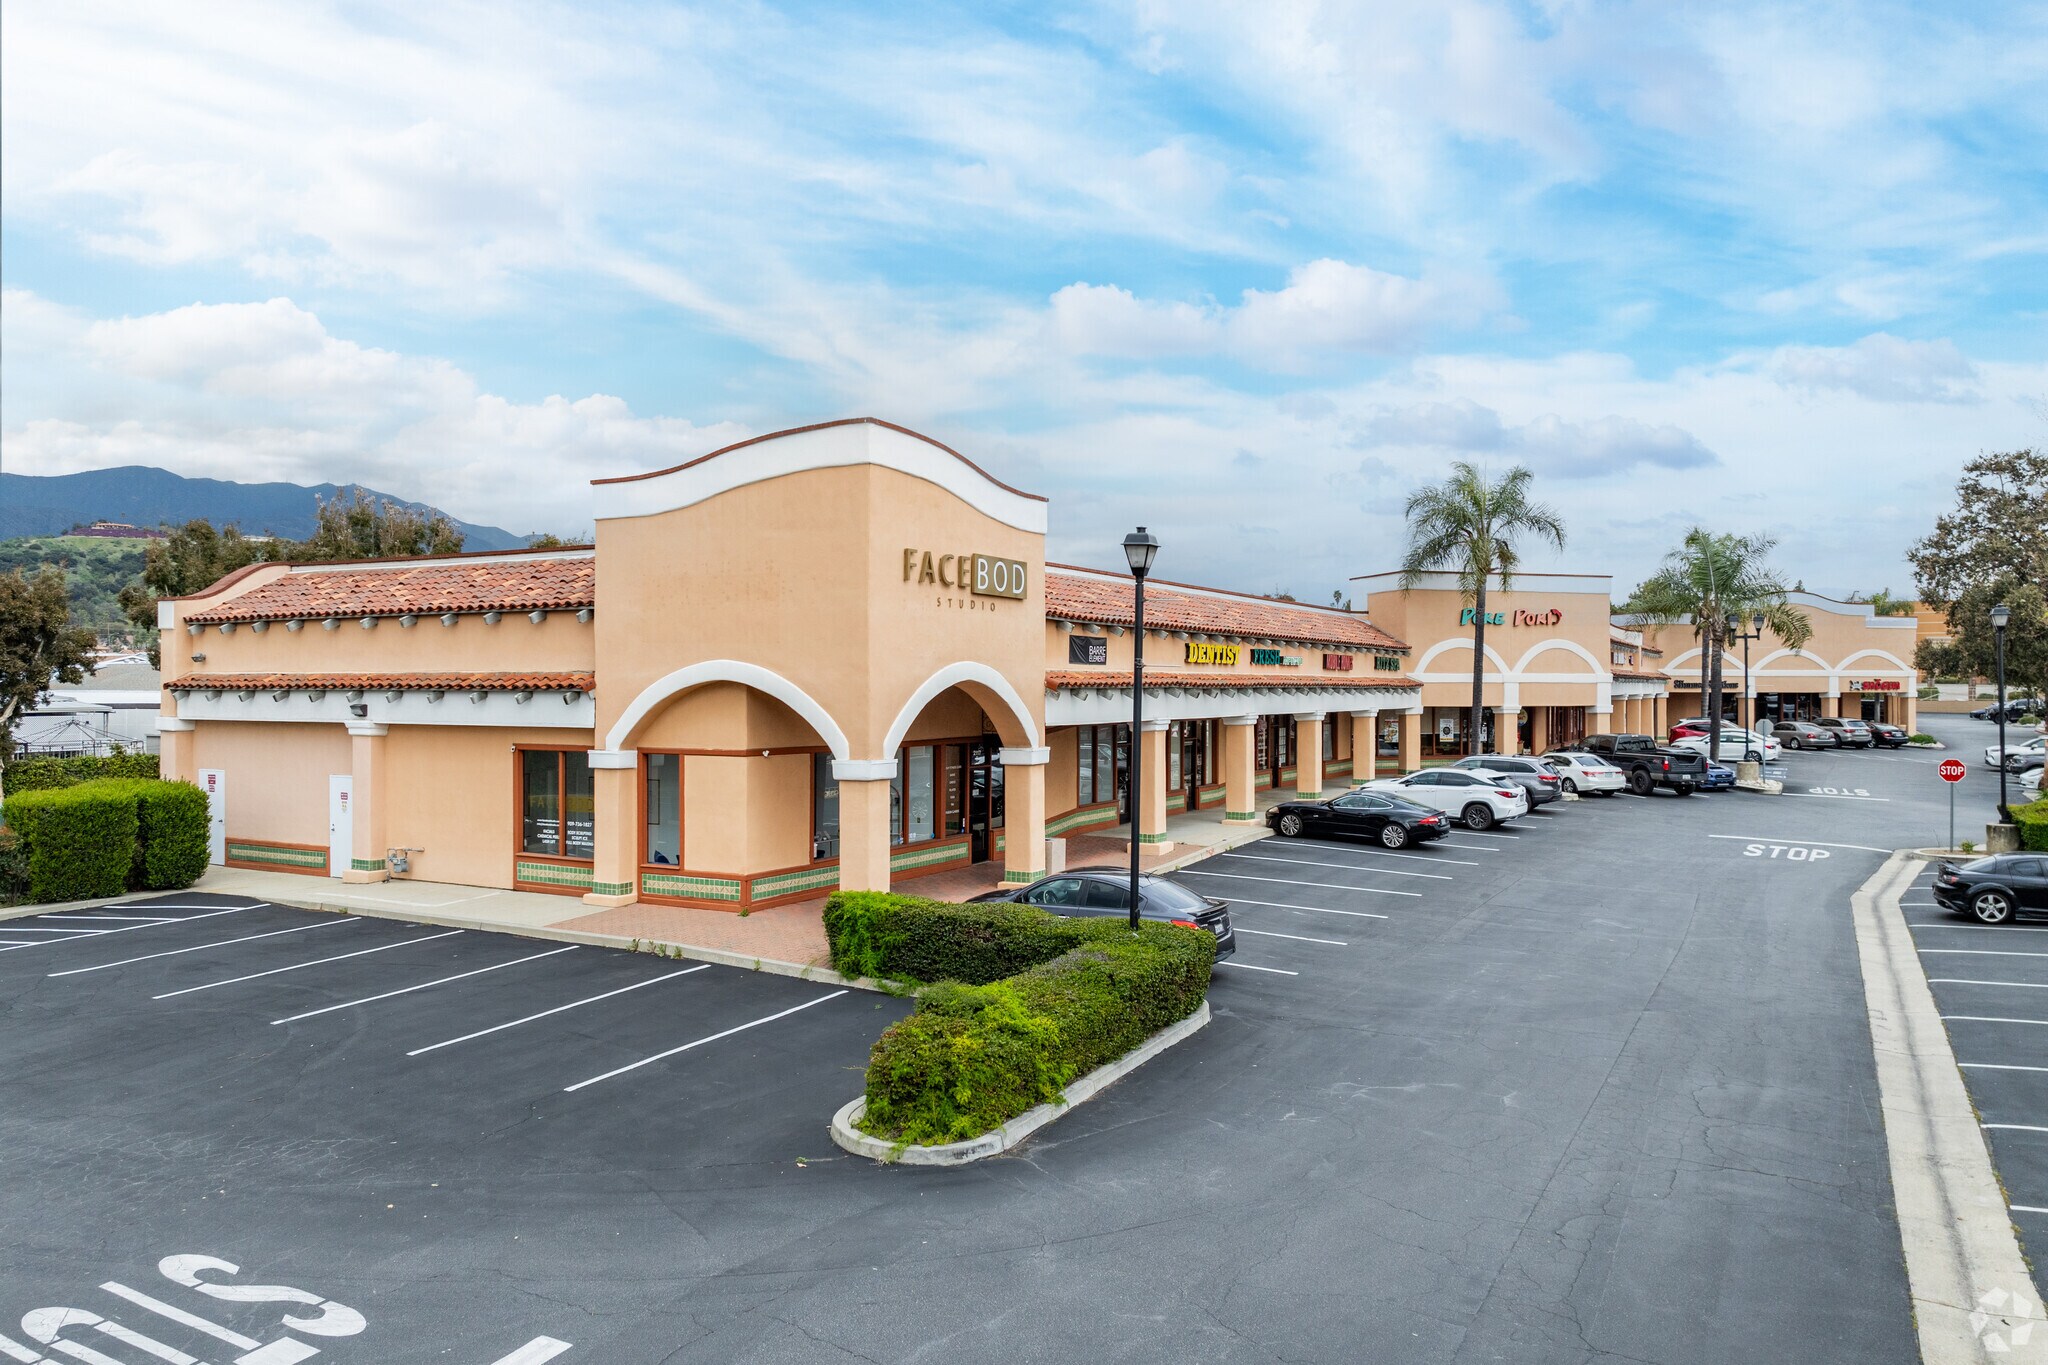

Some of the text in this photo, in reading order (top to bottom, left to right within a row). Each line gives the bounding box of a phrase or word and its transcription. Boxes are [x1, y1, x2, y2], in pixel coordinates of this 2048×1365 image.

[903, 548, 1026, 594] FACEBOD
[937, 597, 996, 612] STUDIO
[1089, 646, 1106, 656] BARRE
[1186, 643, 1240, 665] DENTIST
[1251, 649, 1281, 665] FRESH
[1940, 766, 1964, 775] STOP
[1809, 787, 1870, 797] STOP
[1743, 844, 1830, 862] STOP
